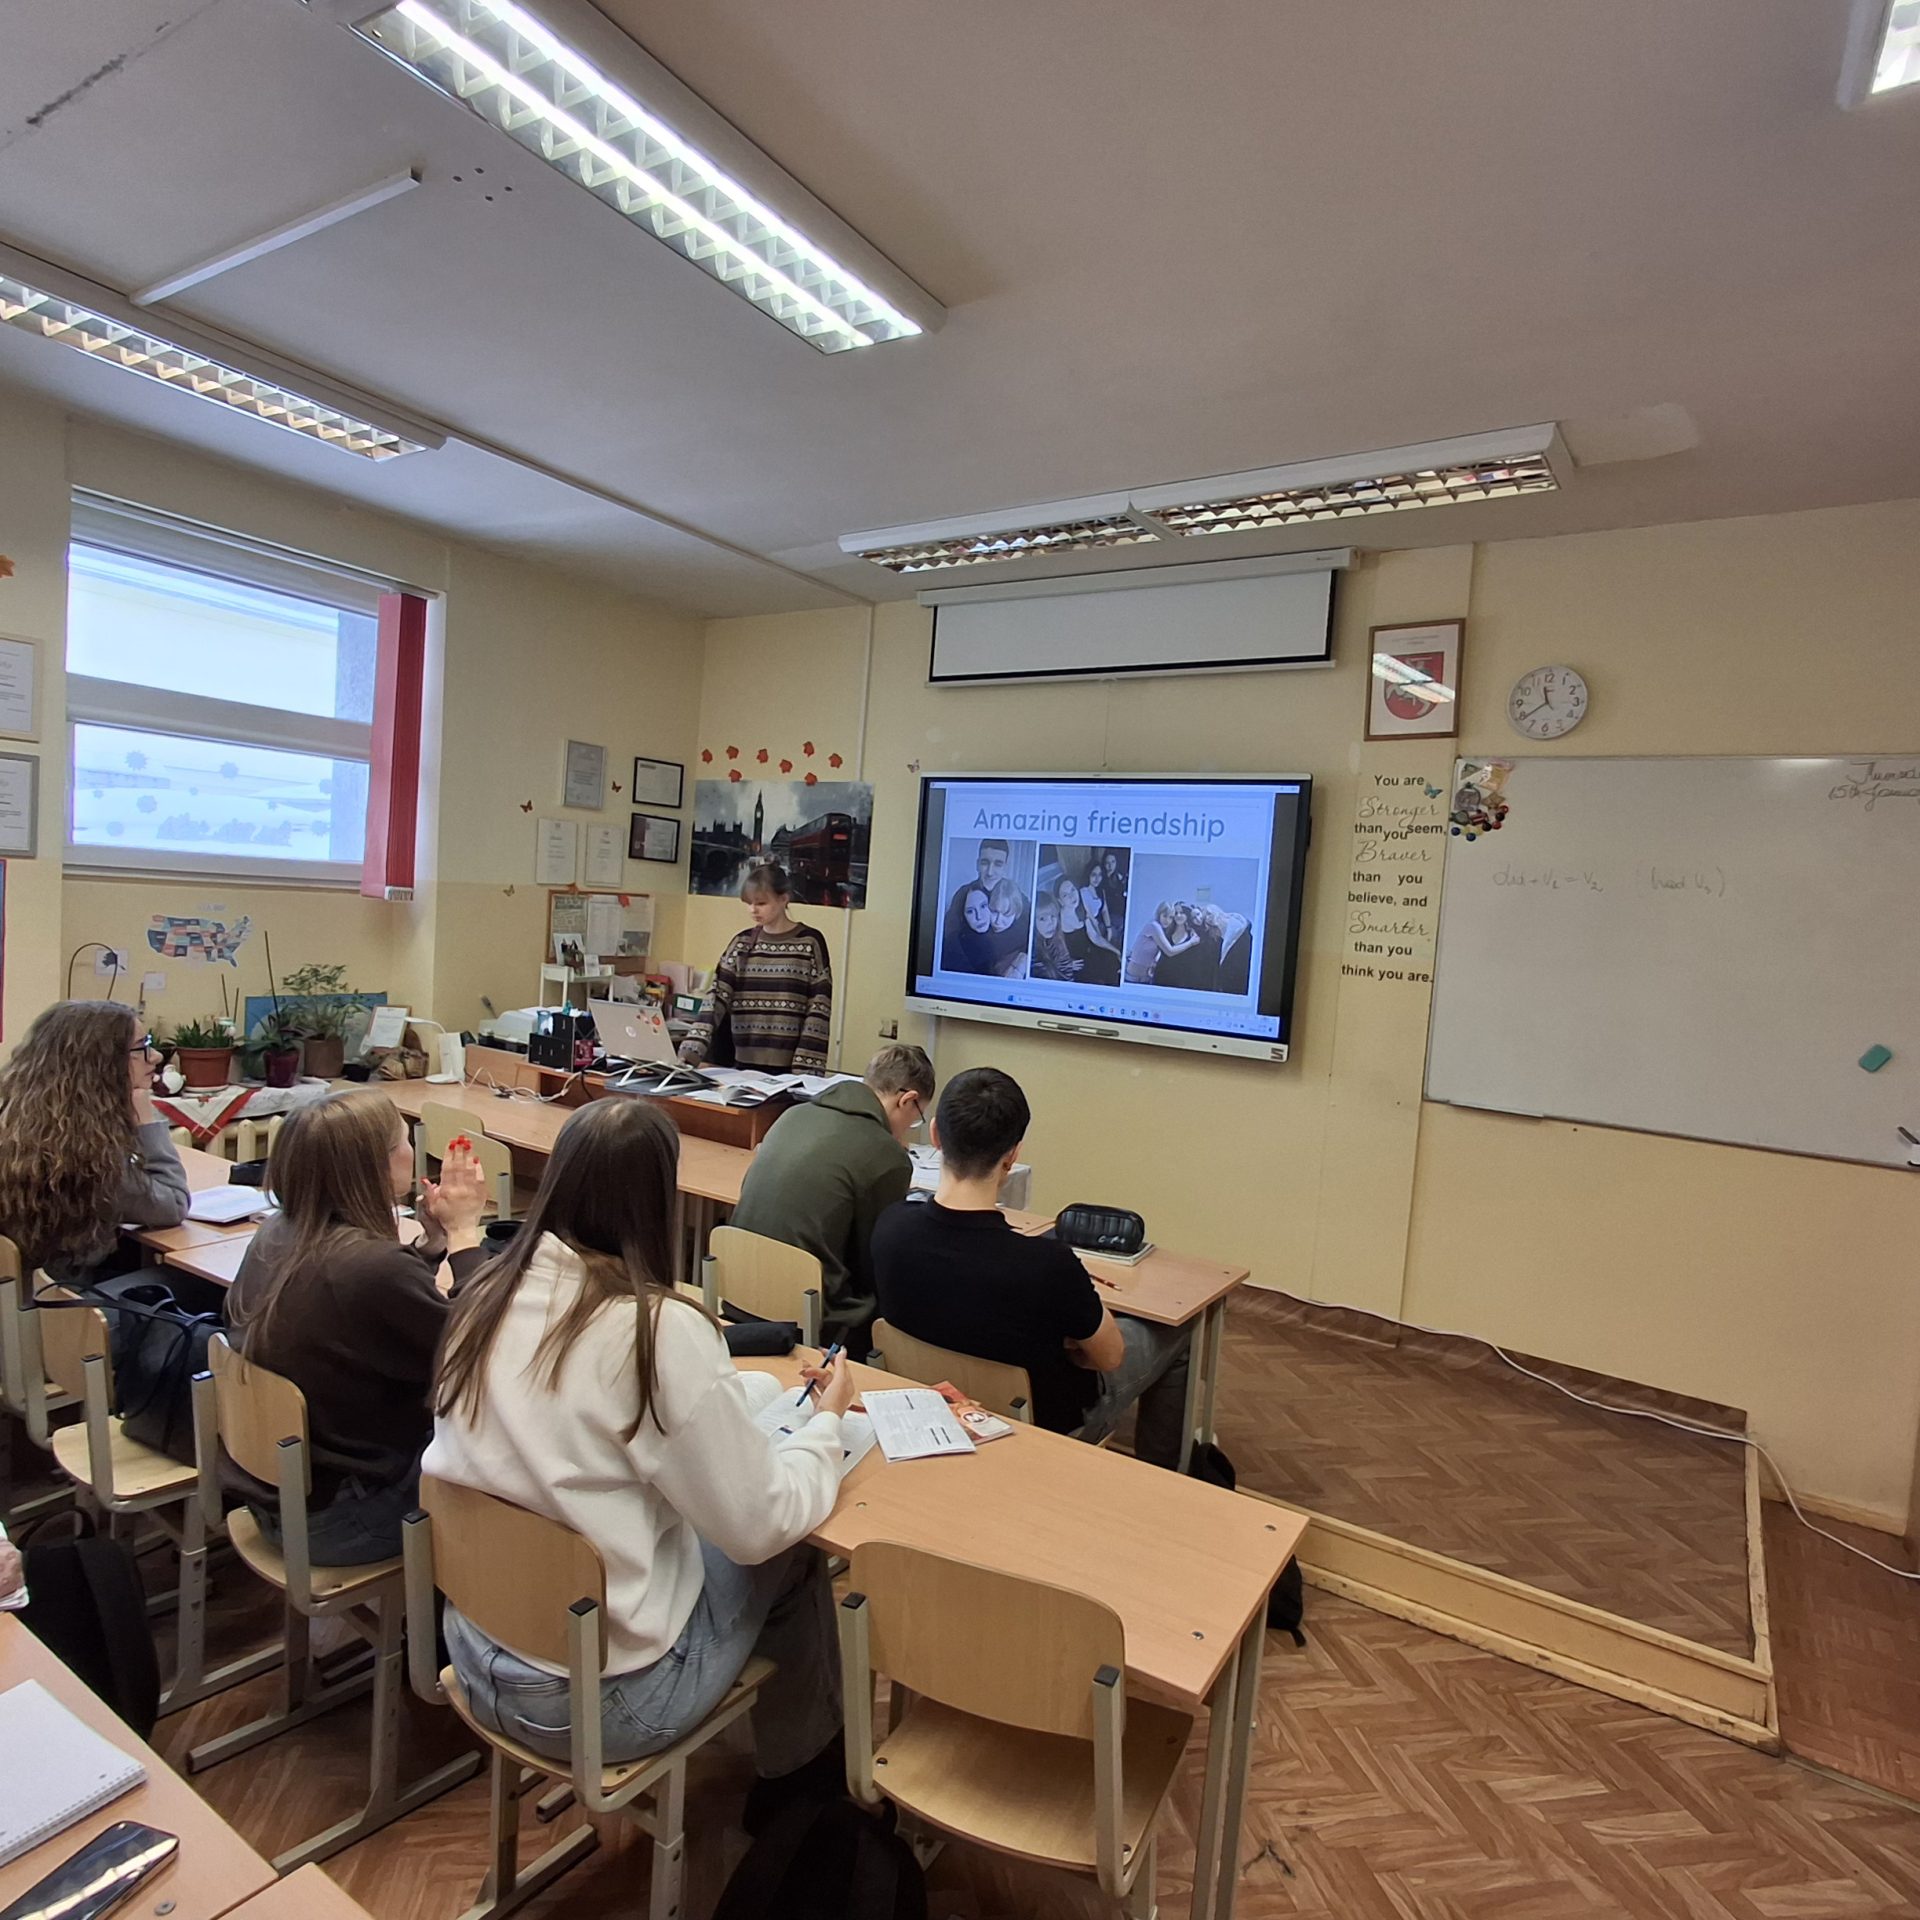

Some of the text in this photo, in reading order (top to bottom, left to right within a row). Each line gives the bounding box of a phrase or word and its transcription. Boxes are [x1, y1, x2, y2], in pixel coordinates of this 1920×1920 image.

[1545, 673, 1555, 683] 12
[1569, 685, 1576, 695] 2
[1516, 698, 1524, 709] 9
[1572, 697, 1580, 707] 3
[1566, 709, 1574, 718] 4
[1526, 719, 1536, 733] 7
[1541, 722, 1549, 733] 6
[1374, 774, 1425, 787] You are
[1358, 796, 1440, 829] Stronger
[973, 808, 1226, 843] Amazing friendship
[1354, 822, 1447, 842] than you seem,
[1355, 840, 1432, 863] Braver
[1352, 871, 1423, 886] than you
[1347, 890, 1428, 908] believe, and
[1349, 911, 1430, 937] Smarter
[1354, 941, 1413, 956] than you
[1341, 964, 1434, 984] think you are.
